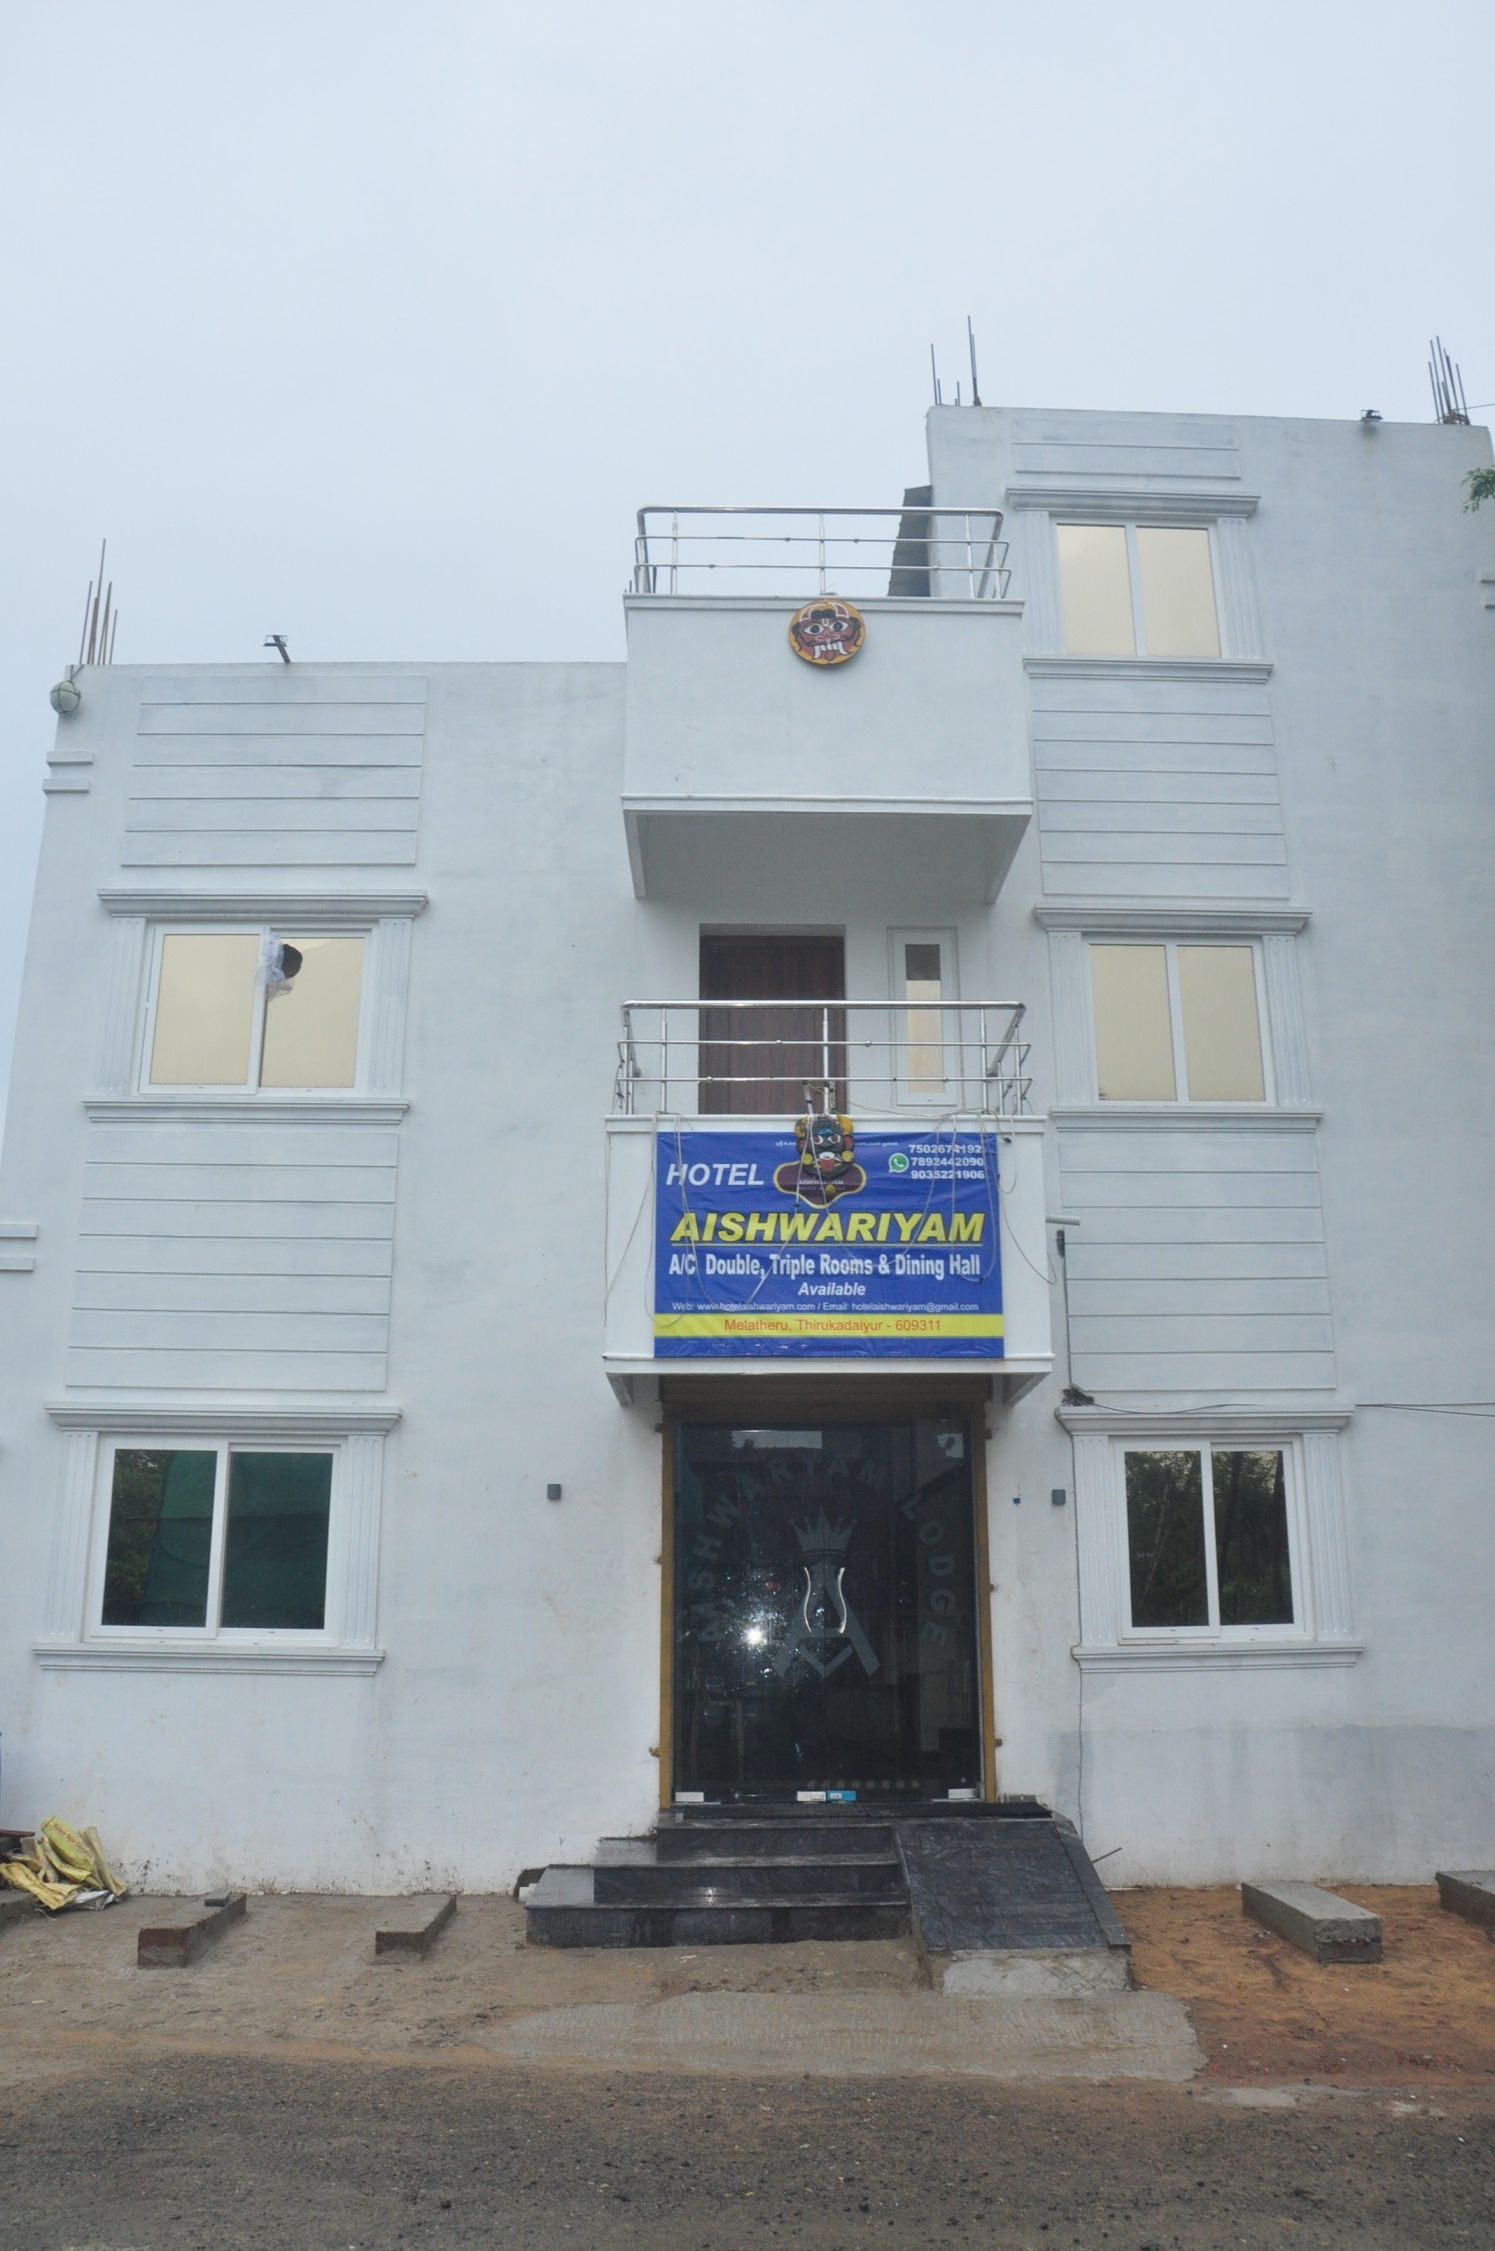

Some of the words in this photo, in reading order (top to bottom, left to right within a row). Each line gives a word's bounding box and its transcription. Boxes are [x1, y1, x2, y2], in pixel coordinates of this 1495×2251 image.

[910, 1157, 985, 1167] 7892442090
[665, 1163, 765, 1186] HOTEL
[911, 1170, 986, 1180] 9035221906
[670, 1212, 986, 1243] AISHWARIYAM
[669, 1254, 696, 1276] A/C
[705, 1254, 766, 1279] Double,
[769, 1254, 815, 1280] Triple
[820, 1254, 873, 1276] Rooms
[878, 1255, 891, 1275] &
[895, 1254, 945, 1281] Dining
[950, 1255, 980, 1276] Hall
[798, 1282, 866, 1297] Available
[823, 1302, 849, 1311] Email:
[852, 1302, 979, 1313] hotelaishwariyam@gmail.com
[724, 1319, 792, 1332] Melatheru,
[796, 1319, 883, 1334] Thirukadaiyur
[895, 1320, 942, 1332] 609311
